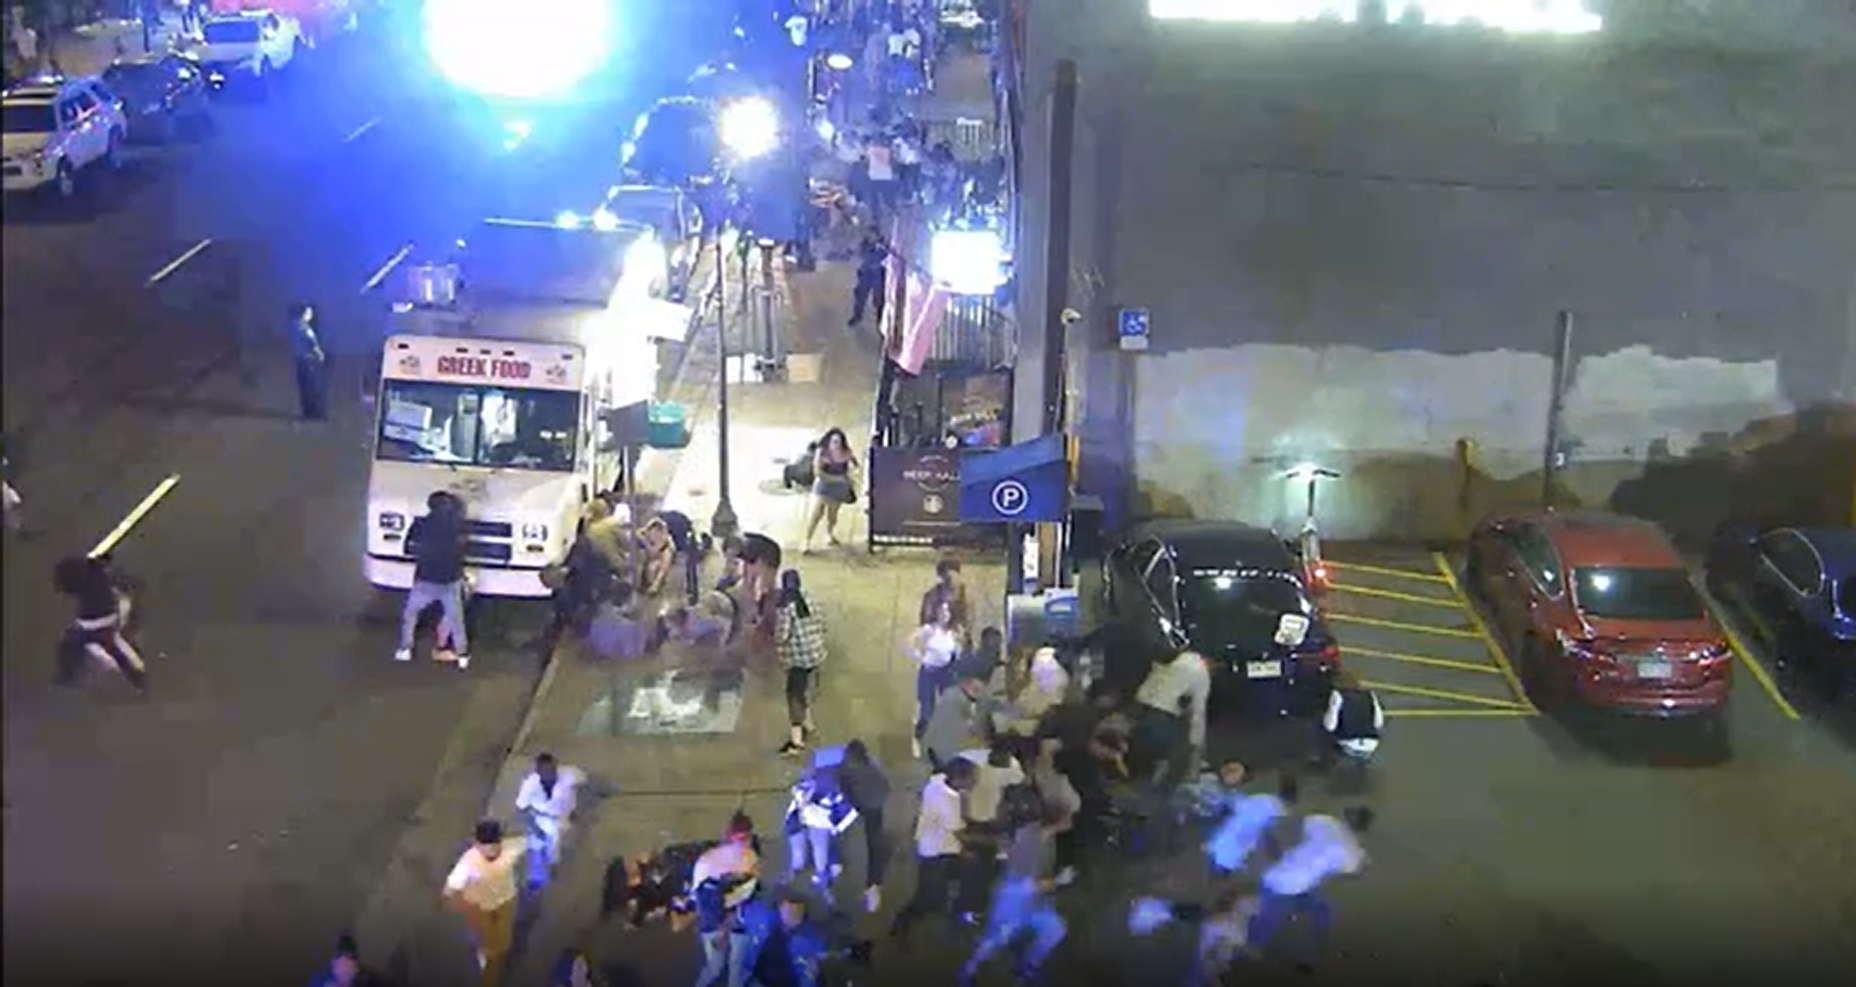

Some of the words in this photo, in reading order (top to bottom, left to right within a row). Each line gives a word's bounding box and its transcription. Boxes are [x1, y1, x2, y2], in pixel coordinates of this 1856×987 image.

[437, 355, 487, 376] GREEK
[491, 359, 532, 379] FOOD
[1002, 487, 1019, 507] P
